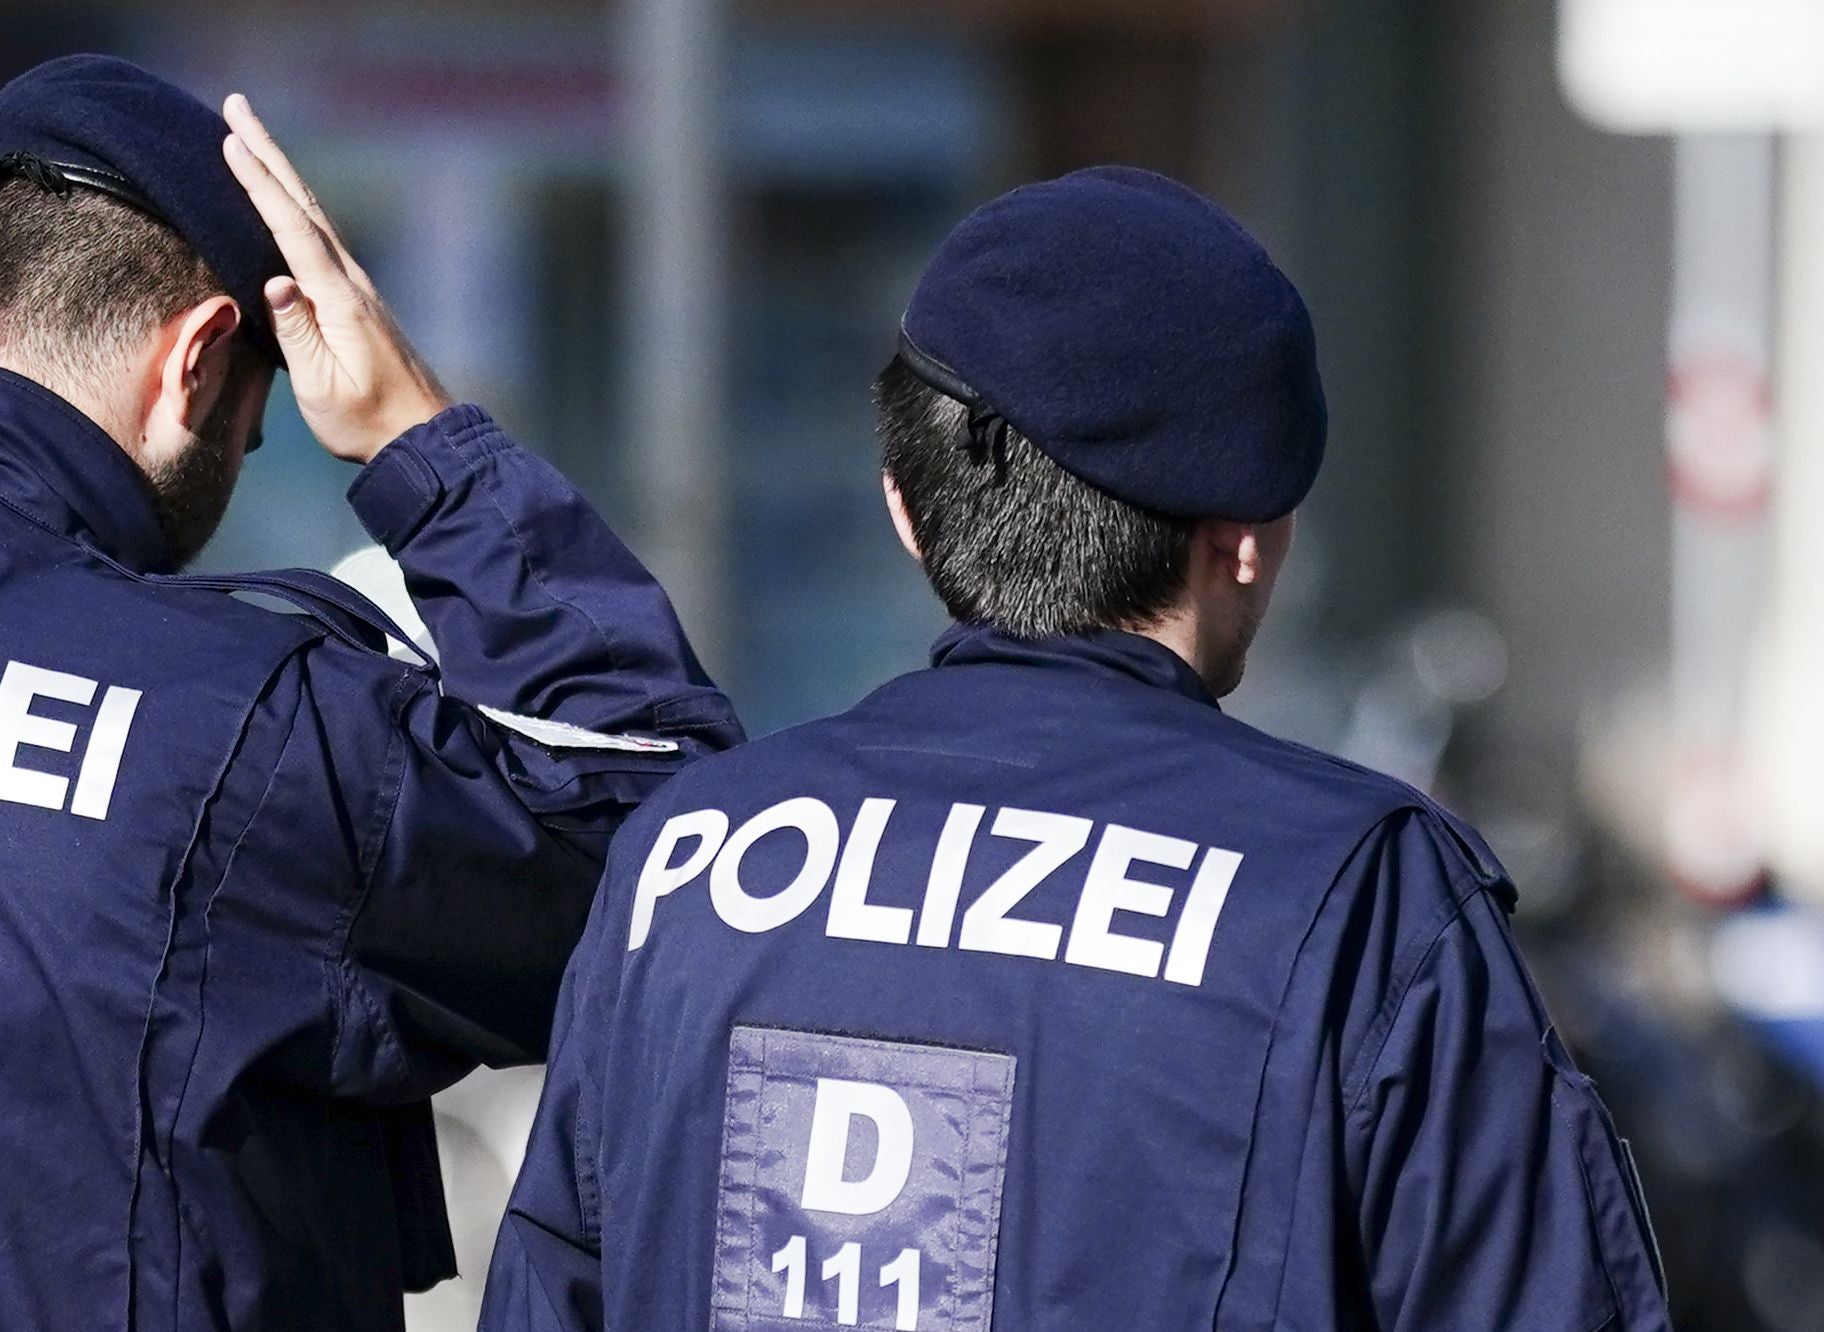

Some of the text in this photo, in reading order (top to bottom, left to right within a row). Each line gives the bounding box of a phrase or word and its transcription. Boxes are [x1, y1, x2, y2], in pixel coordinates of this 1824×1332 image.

[627, 797, 1243, 986] POLIZEI
[801, 1077, 915, 1216] D
[771, 1234, 921, 1332] 111
